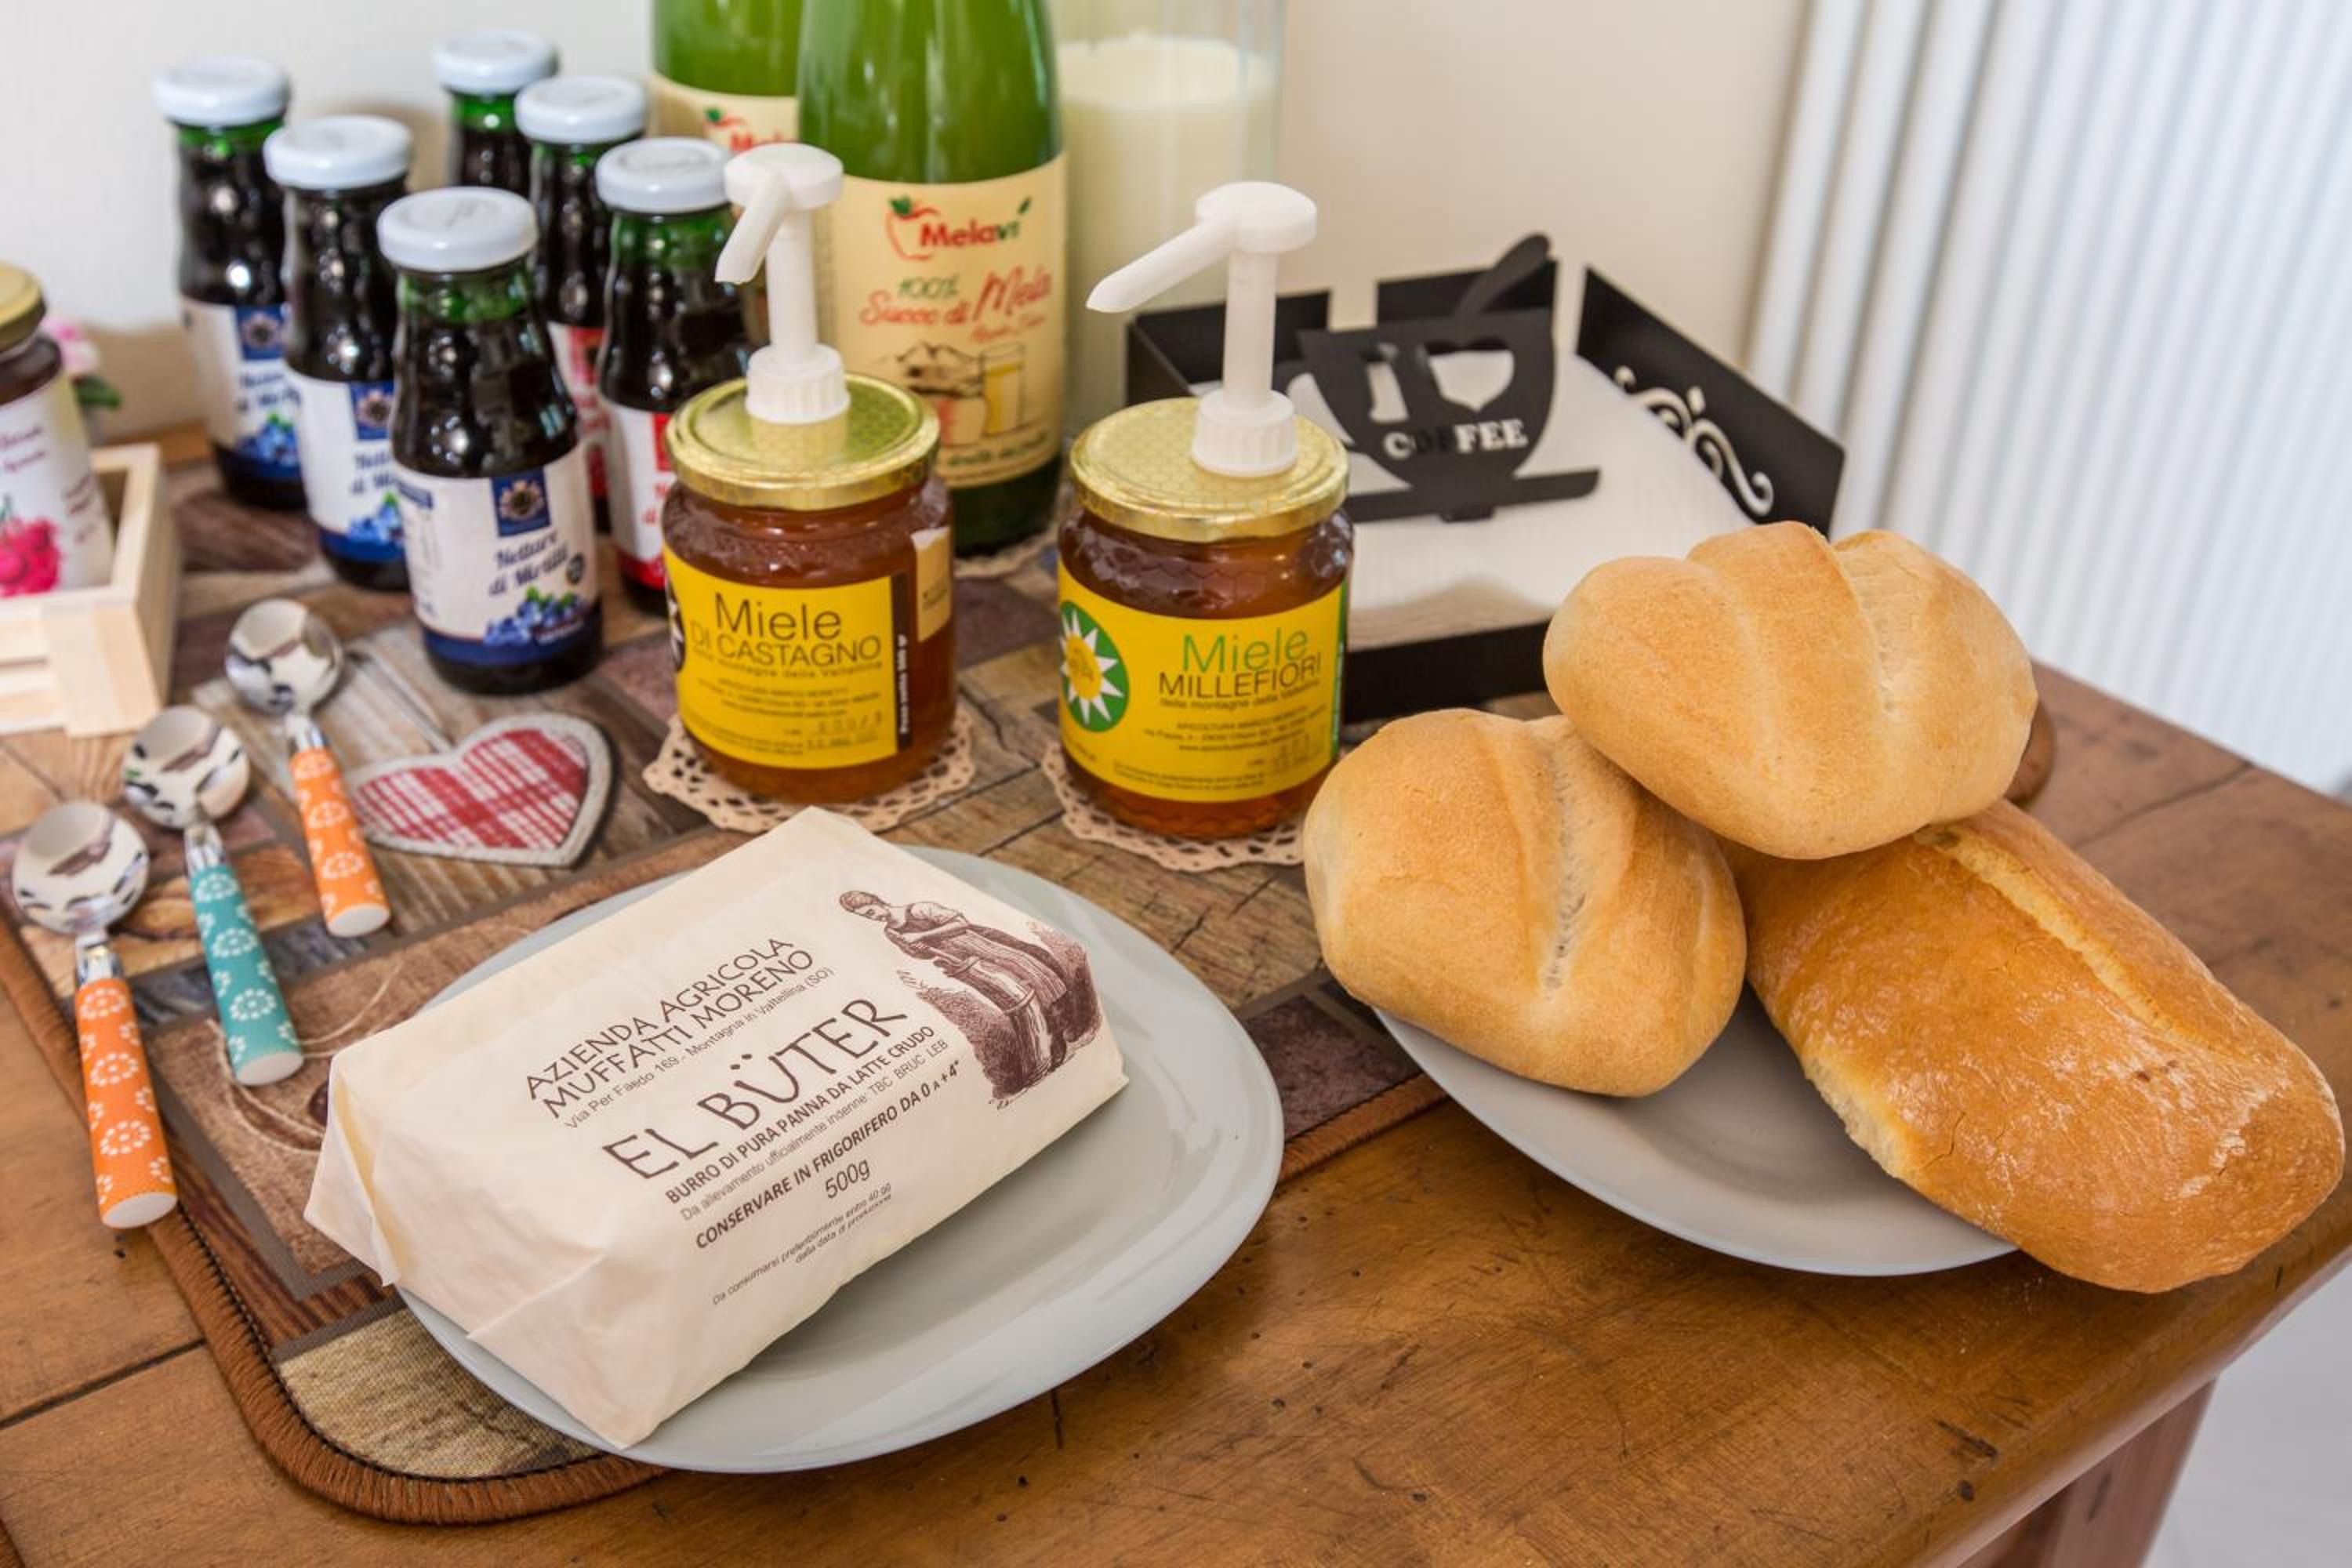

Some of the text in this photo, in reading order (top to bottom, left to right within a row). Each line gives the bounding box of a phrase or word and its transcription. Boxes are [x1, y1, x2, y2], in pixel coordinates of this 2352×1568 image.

[898, 275, 959, 298] 100%
[945, 299, 971, 325] di
[971, 265, 1051, 321] Mela
[1384, 418, 1529, 460] COFFEE
[690, 619, 710, 650] DI
[717, 635, 882, 667] CASTAGNO
[715, 592, 841, 641] Miele
[1159, 652, 1321, 699] MILLEFIORI
[1182, 627, 1308, 673] Miele
[527, 938, 793, 1100] AZIENDA AGRICOLA
[543, 950, 813, 1119] MUFFATTI MORENO
[564, 1110, 590, 1128] Via
[588, 1094, 614, 1112] Per
[685, 1020, 745, 1057] Montagna
[804, 967, 834, 988] (SO)
[601, 998, 908, 1179] EL BÜTER
[665, 1025, 935, 1203] BURRO DI PURA PANNA DA LATTE CRUDO
[680, 1205, 701, 1220] Da
[701, 1162, 765, 1209] allevamento
[869, 1076, 893, 1094] TBC
[893, 1054, 926, 1080] BRUC
[696, 1177, 793, 1249] CONSERVARE
[793, 1165, 811, 1185] IN
[812, 1105, 898, 1174] FRIGORIFERO
[899, 1091, 921, 1113] DA
[920, 1083, 931, 1098] 0
[825, 1160, 870, 1199] 500g
